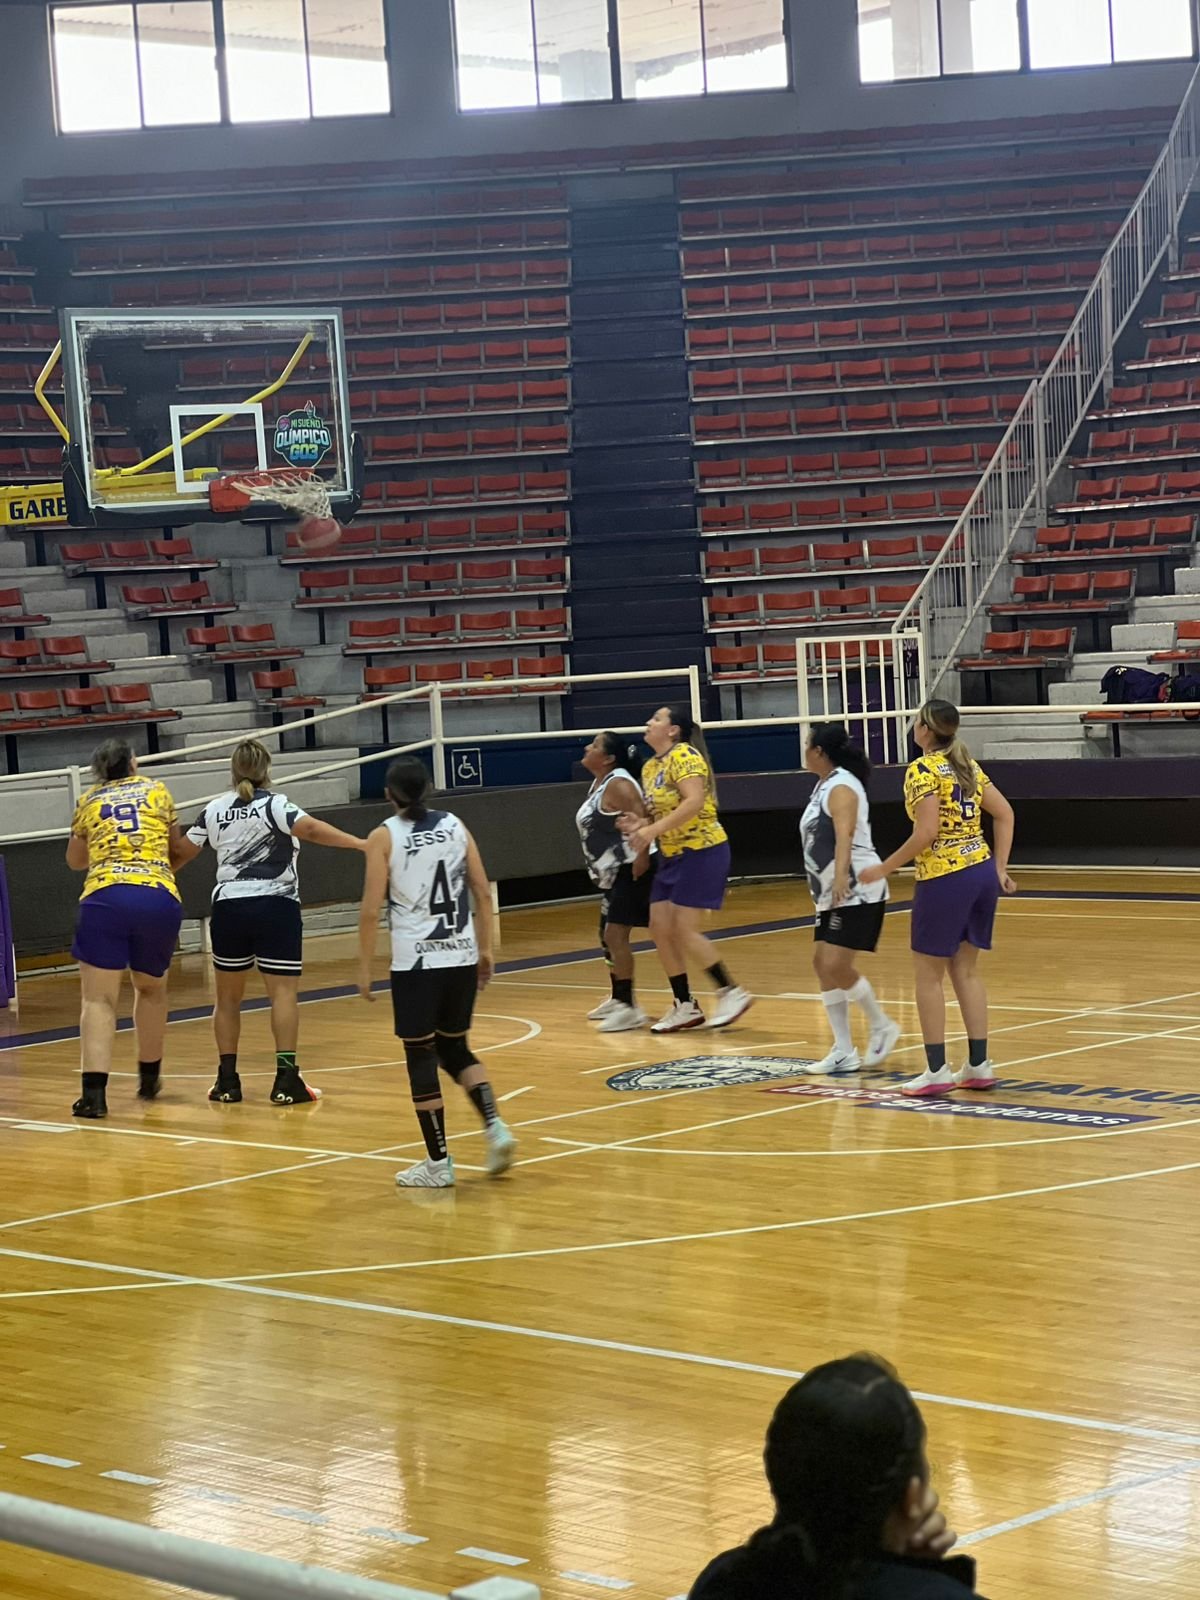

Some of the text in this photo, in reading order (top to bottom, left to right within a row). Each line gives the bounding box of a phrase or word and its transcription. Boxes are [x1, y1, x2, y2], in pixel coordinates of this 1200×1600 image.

[276, 429, 330, 448] OLÍMPICO
[113, 803, 140, 834] 9
[216, 807, 261, 823] LUISA
[403, 828, 456, 850] JESSY
[959, 840, 981, 856] 2025
[429, 859, 459, 929] 4
[414, 939, 457, 954] QUINTANA
